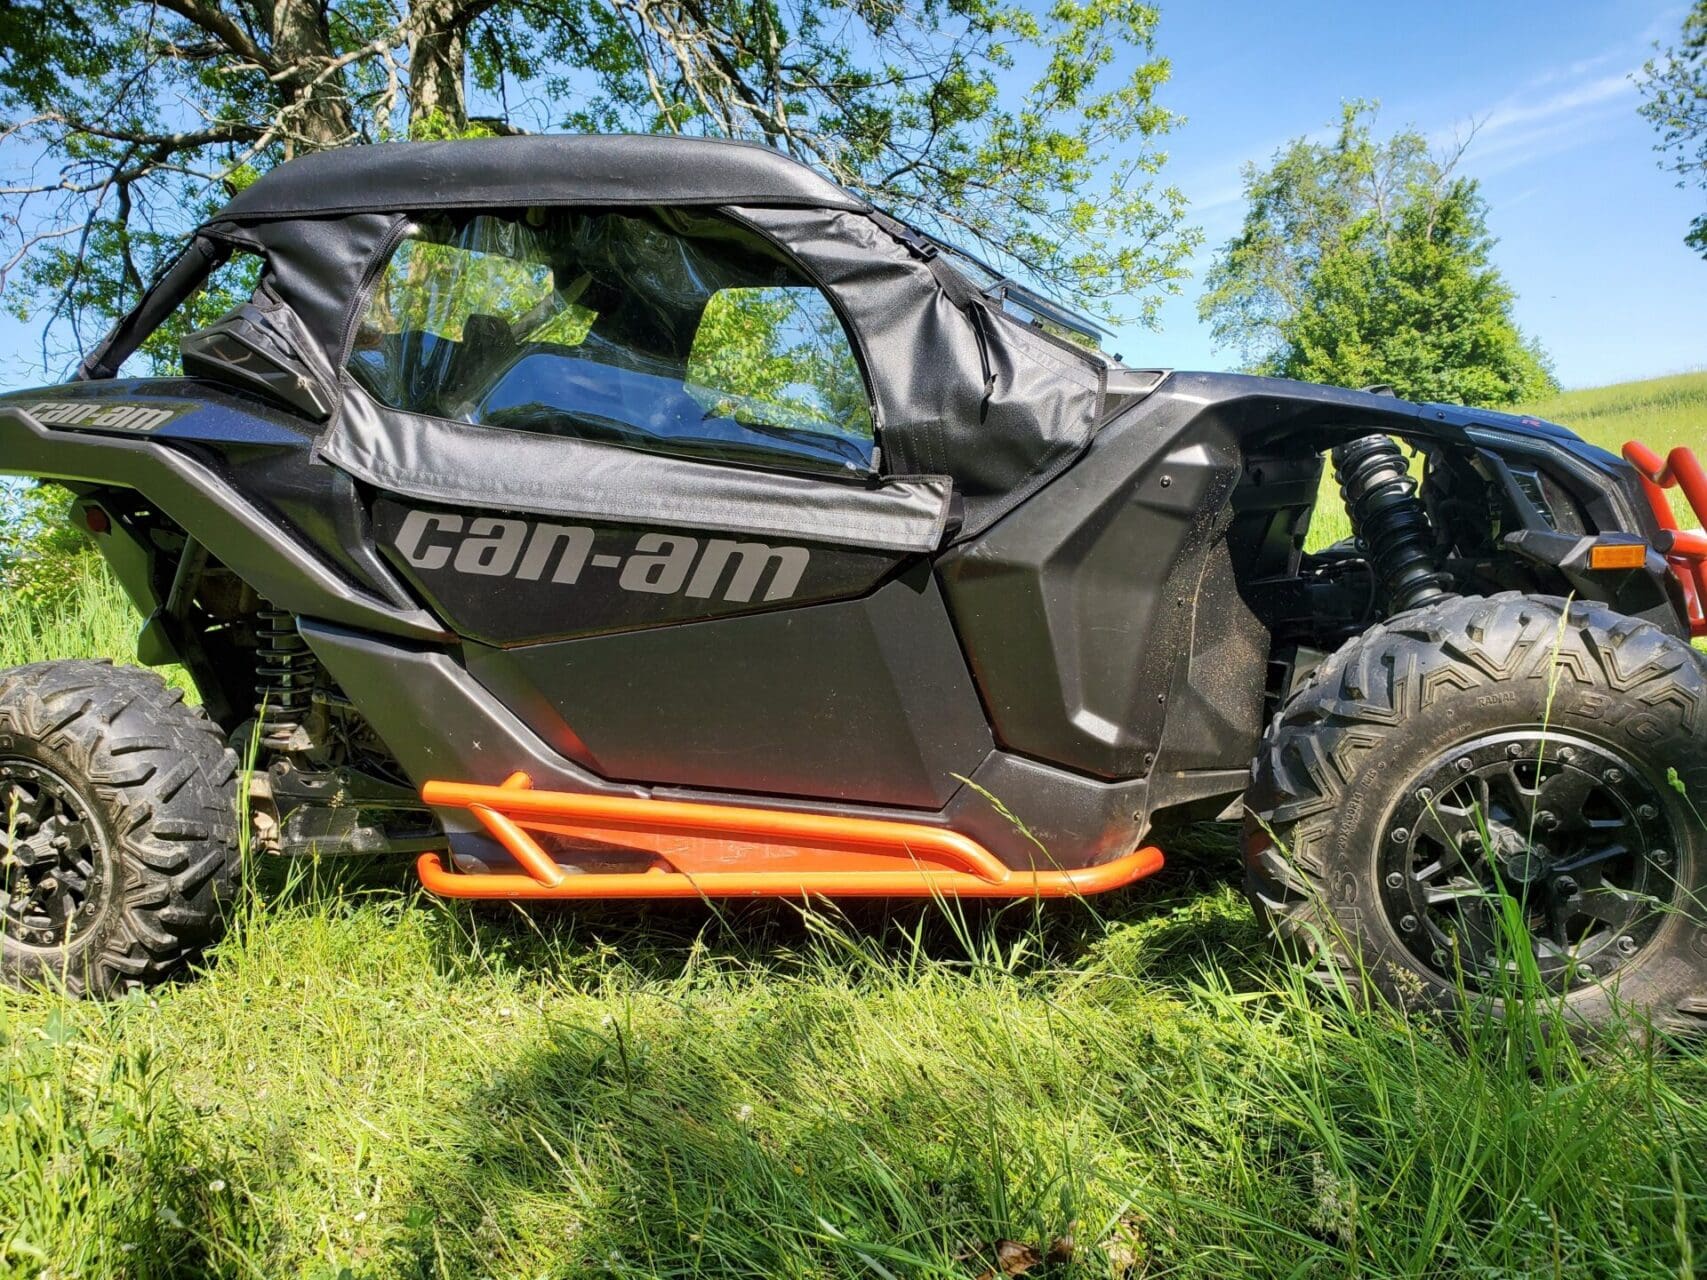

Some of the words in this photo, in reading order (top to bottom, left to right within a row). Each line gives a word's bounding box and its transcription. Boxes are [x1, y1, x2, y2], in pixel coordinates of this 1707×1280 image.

[26, 402, 174, 431] can-am
[394, 510, 810, 603] can-am
[1477, 691, 1516, 707] RADIAL
